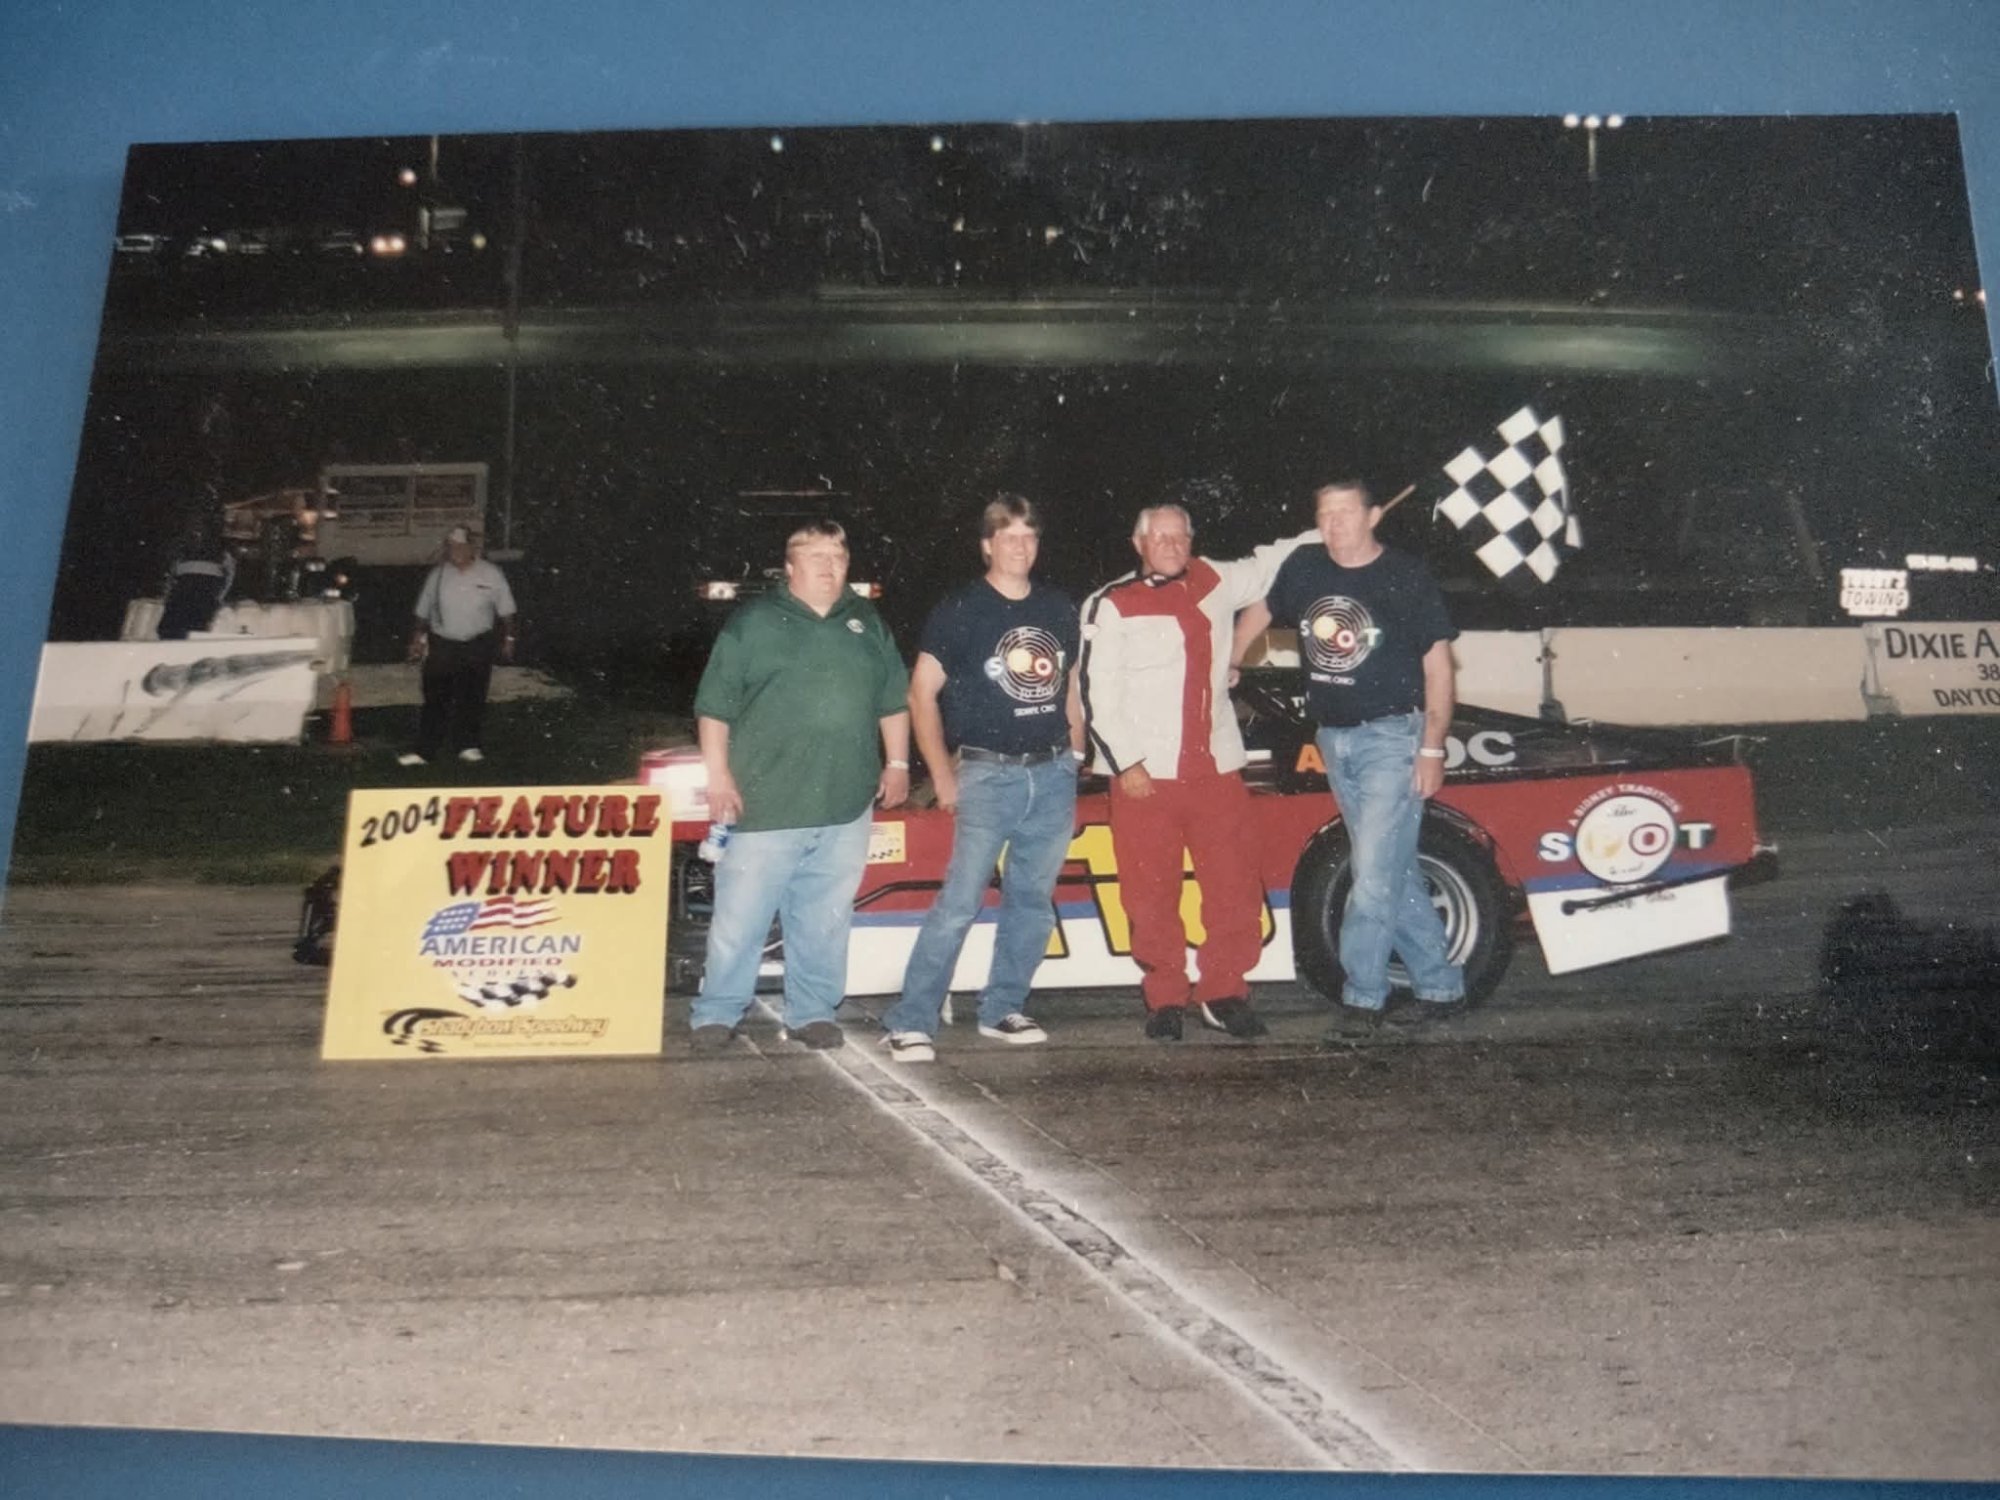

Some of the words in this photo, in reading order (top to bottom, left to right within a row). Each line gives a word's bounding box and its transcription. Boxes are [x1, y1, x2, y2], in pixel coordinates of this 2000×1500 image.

[1885, 627, 1967, 659] DIXIE
[360, 796, 440, 848] 2004
[440, 794, 662, 839] FEATURE
[446, 849, 641, 896] WINNER
[419, 935, 582, 956] AMERICAN
[432, 957, 563, 968] MODIFIED
